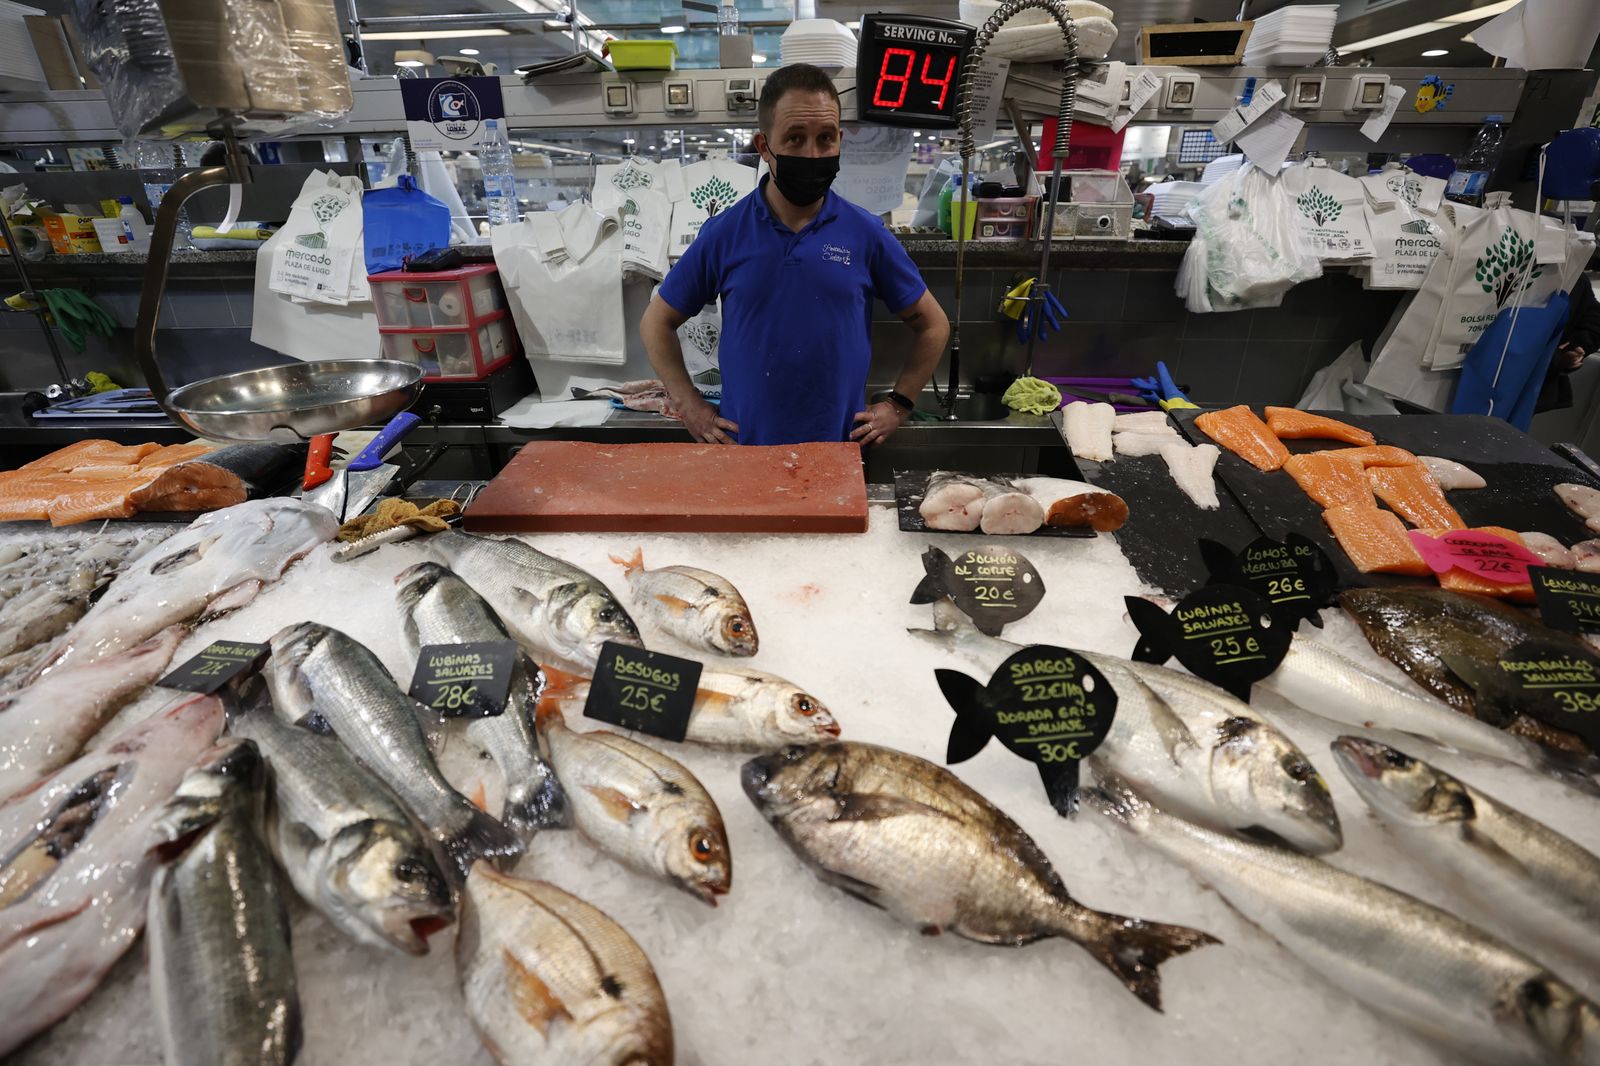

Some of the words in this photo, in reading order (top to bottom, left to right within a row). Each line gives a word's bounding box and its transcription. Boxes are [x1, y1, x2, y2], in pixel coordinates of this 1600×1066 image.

[883, 25, 936, 42] SERVING
[938, 31, 957, 44] No.
[873, 47, 957, 110] 84
[285, 247, 332, 266] mercado
[1394, 249, 1418, 257] PLAZA
[284, 259, 303, 270] PLAZA
[303, 263, 312, 272] DE
[311, 265, 331, 276] LUGO
[1247, 546, 1289, 561] LOMOS
[1294, 545, 1313, 556] DE
[955, 565, 973, 576] AL
[977, 566, 1016, 577] CORTE
[1474, 559, 1521, 574] 22€
[1267, 577, 1306, 595] 26€
[1182, 613, 1250, 633] SALVAJES
[191, 660, 231, 676] 22€
[434, 663, 494, 678] SALVAJES
[1009, 656, 1076, 679] SARGOS
[431, 685, 478, 709] 28€
[620, 684, 667, 713] 25€
[996, 707, 1054, 725] DORADA
[1027, 718, 1087, 736] SALVAJE
[1037, 741, 1081, 763] 30€
